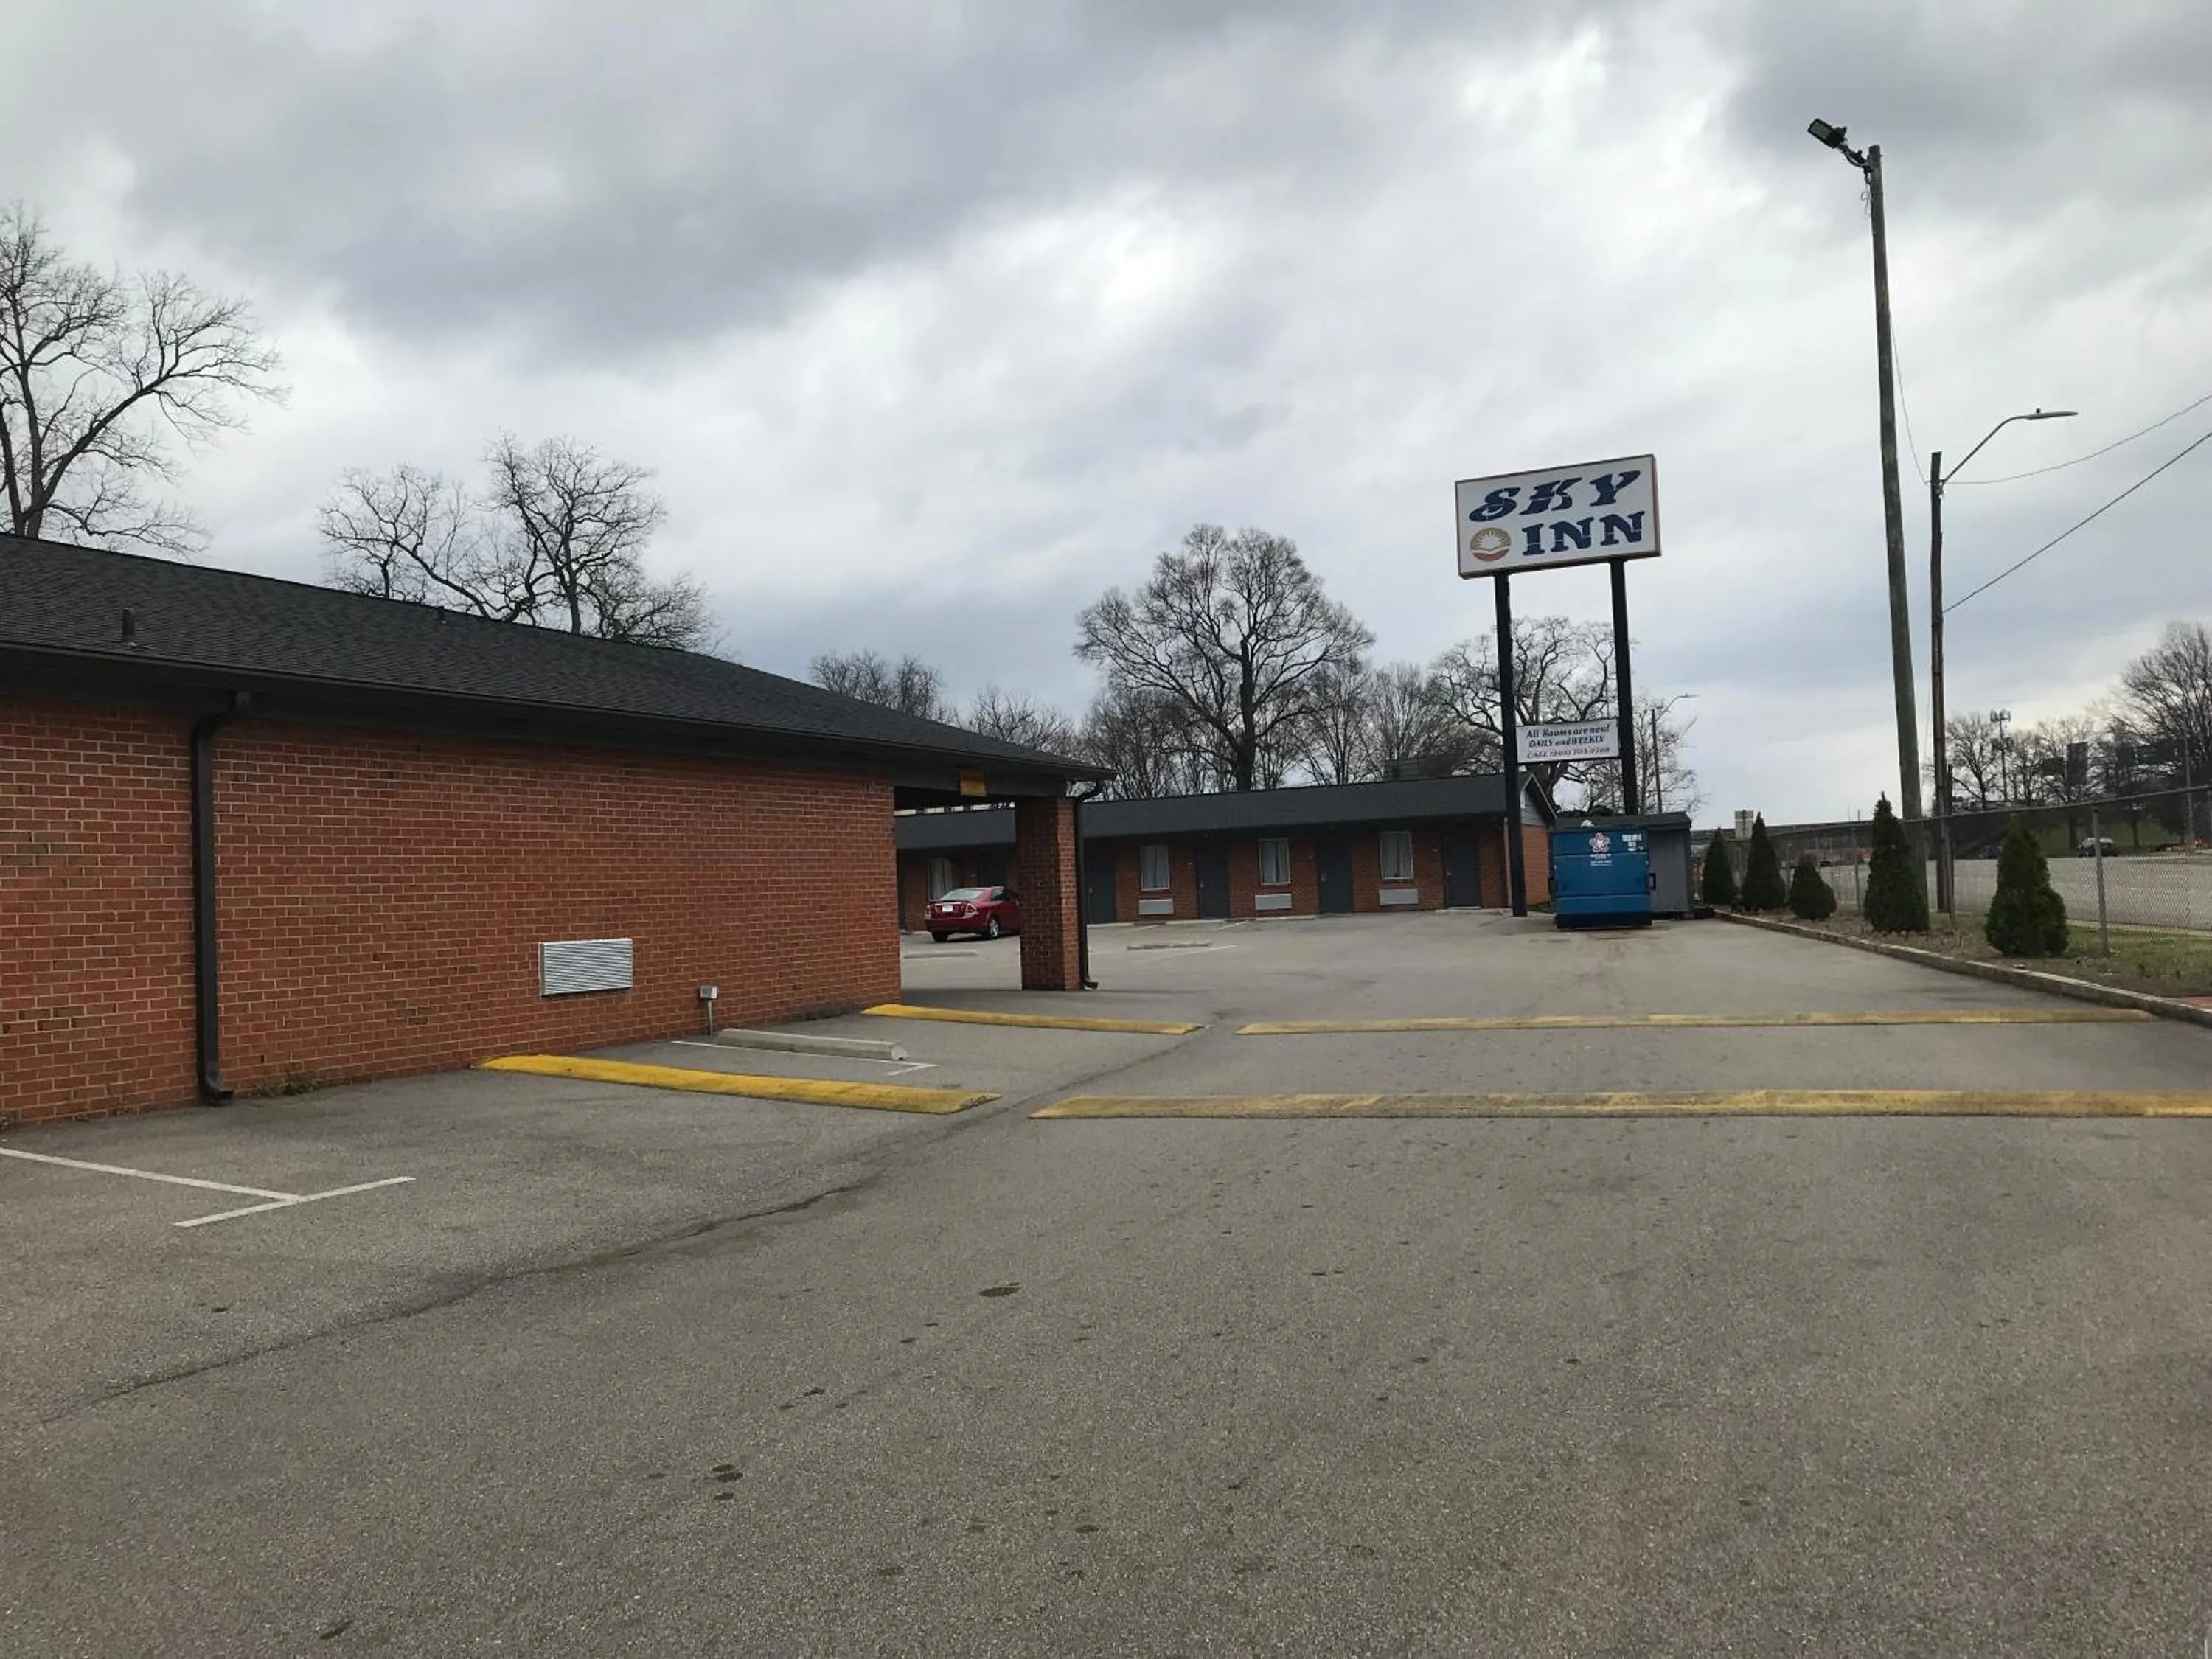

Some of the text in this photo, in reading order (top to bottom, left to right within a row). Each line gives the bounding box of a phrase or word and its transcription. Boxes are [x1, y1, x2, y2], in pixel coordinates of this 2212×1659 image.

[1469, 470, 1641, 522] SKY
[1522, 511, 1645, 556] INN
[1526, 729, 1539, 738] All
[1543, 728, 1572, 737] Rooms
[1573, 727, 1588, 735] are
[1528, 735, 1605, 748] DAILY and WEEKLY
